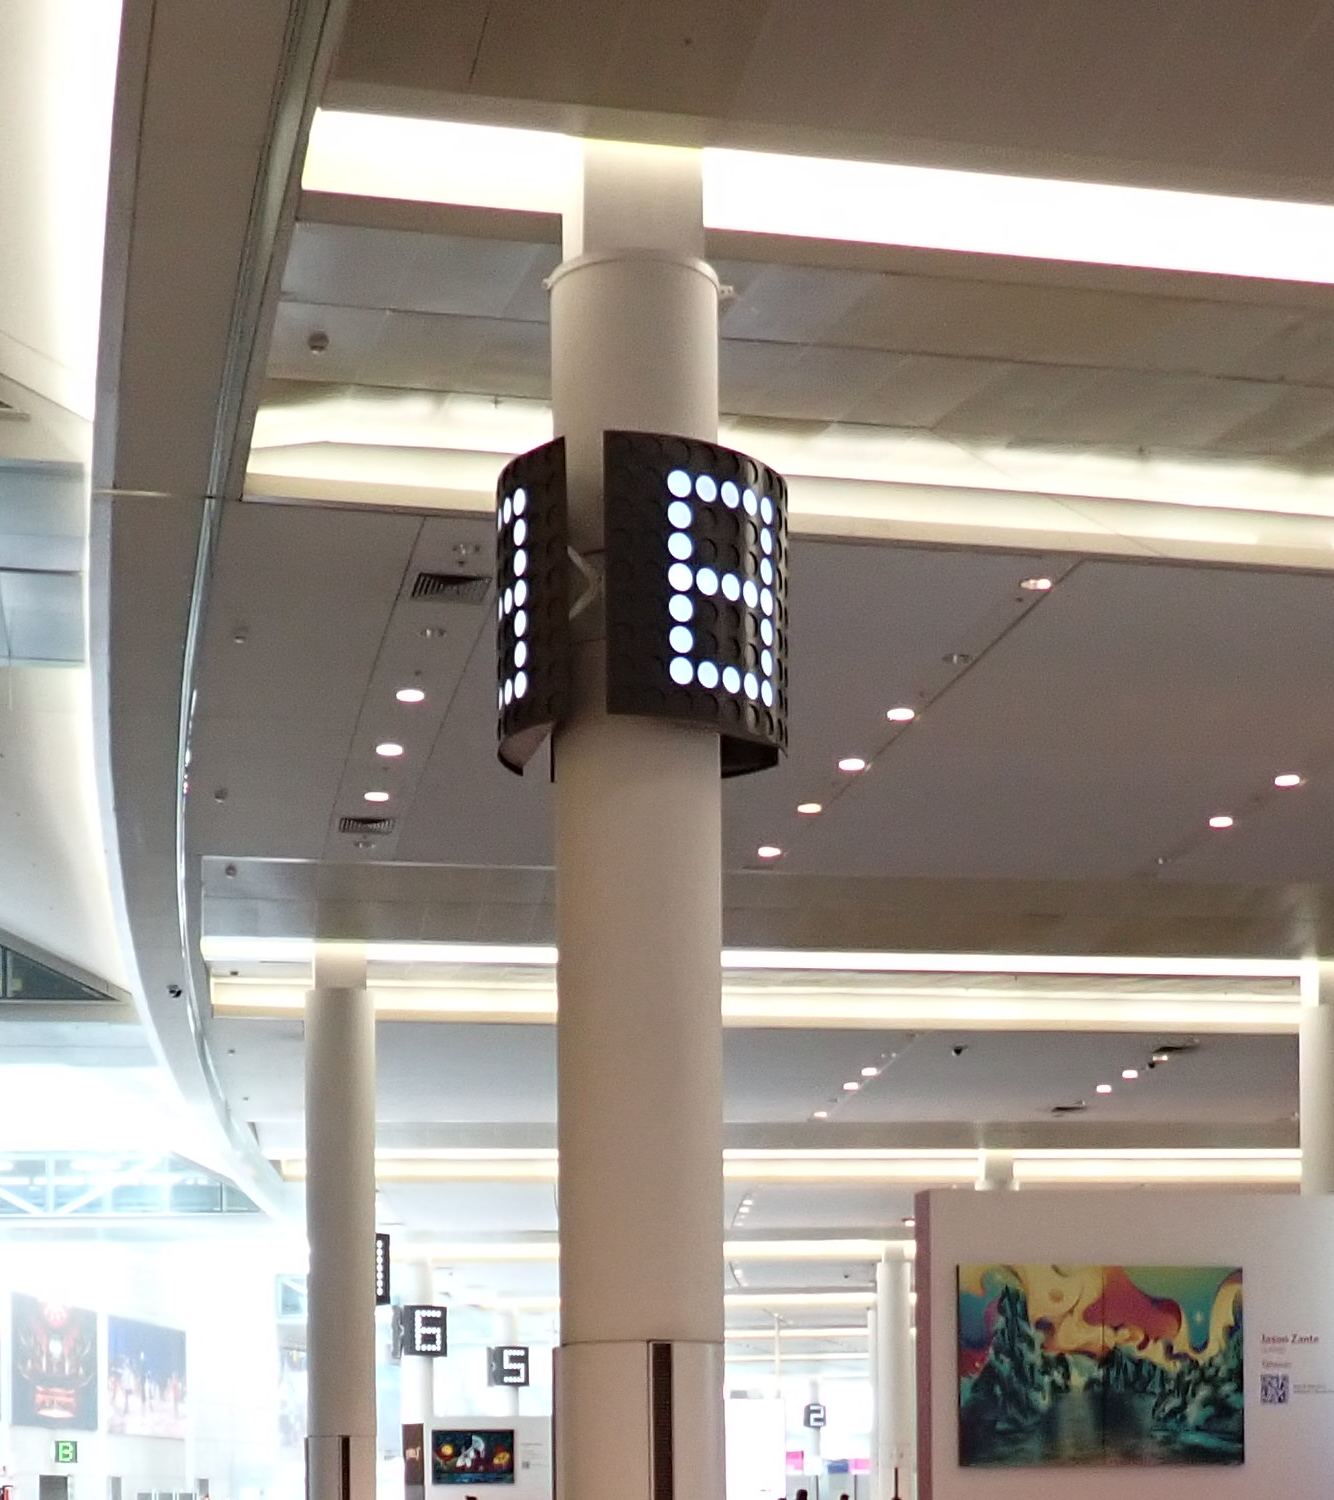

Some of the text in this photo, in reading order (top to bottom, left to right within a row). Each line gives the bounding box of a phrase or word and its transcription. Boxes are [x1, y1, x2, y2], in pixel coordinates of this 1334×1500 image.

[667, 469, 773, 707] 8
[415, 1309, 441, 1351] 6
[503, 1350, 525, 1383] 5
[810, 1405, 824, 1426] 2
[58, 1442, 74, 1462] B
